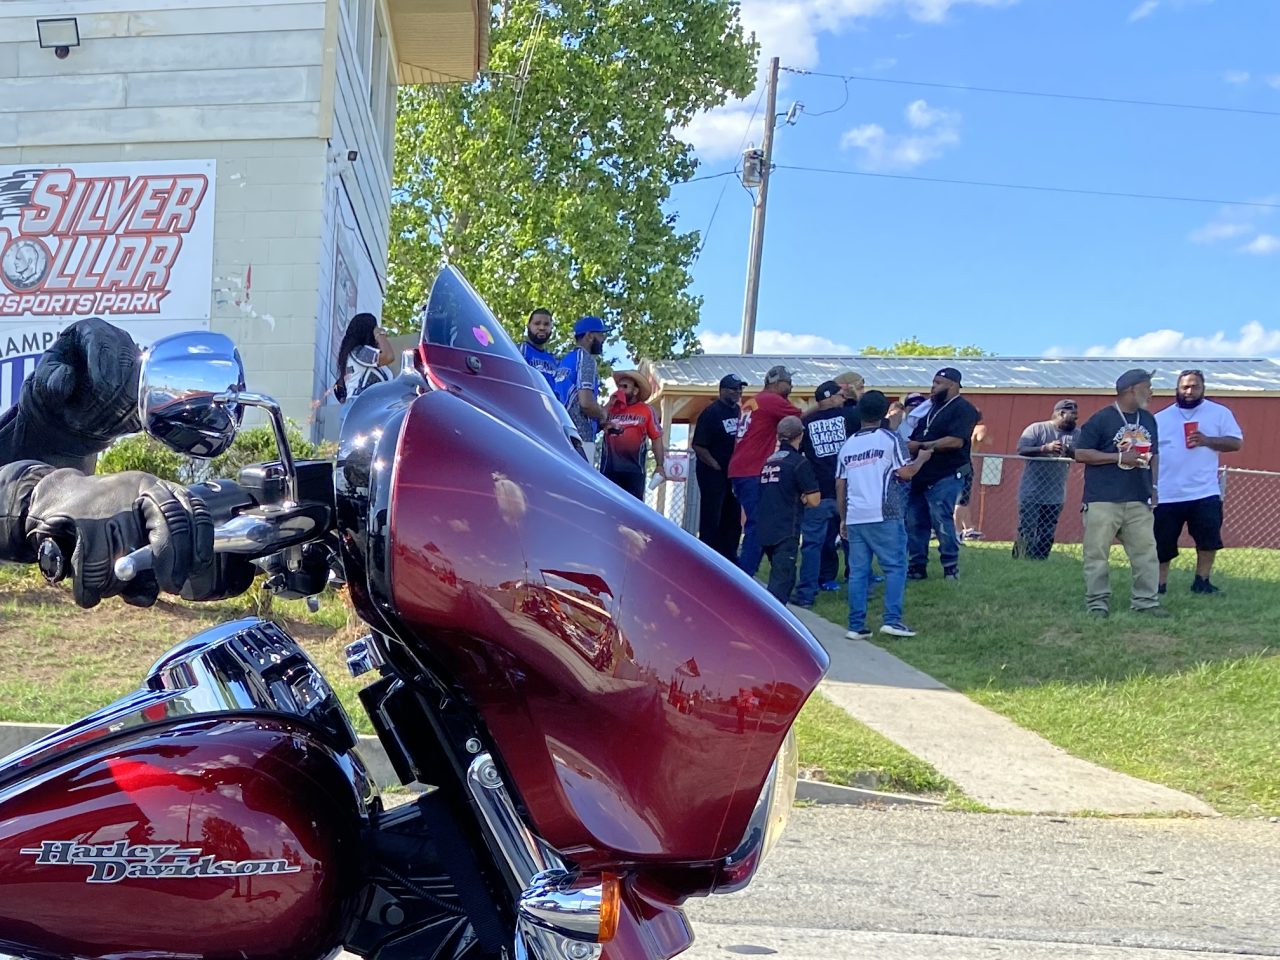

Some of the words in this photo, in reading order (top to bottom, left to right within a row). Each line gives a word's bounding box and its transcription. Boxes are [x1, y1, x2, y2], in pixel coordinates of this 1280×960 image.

[19, 169, 208, 236] SILVER
[94, 290, 170, 314] PARK
[810, 419, 844, 434] PIPES
[812, 430, 845, 445] BAGGS
[25, 840, 199, 865] Harley
[70, 854, 302, 884] Davidson
